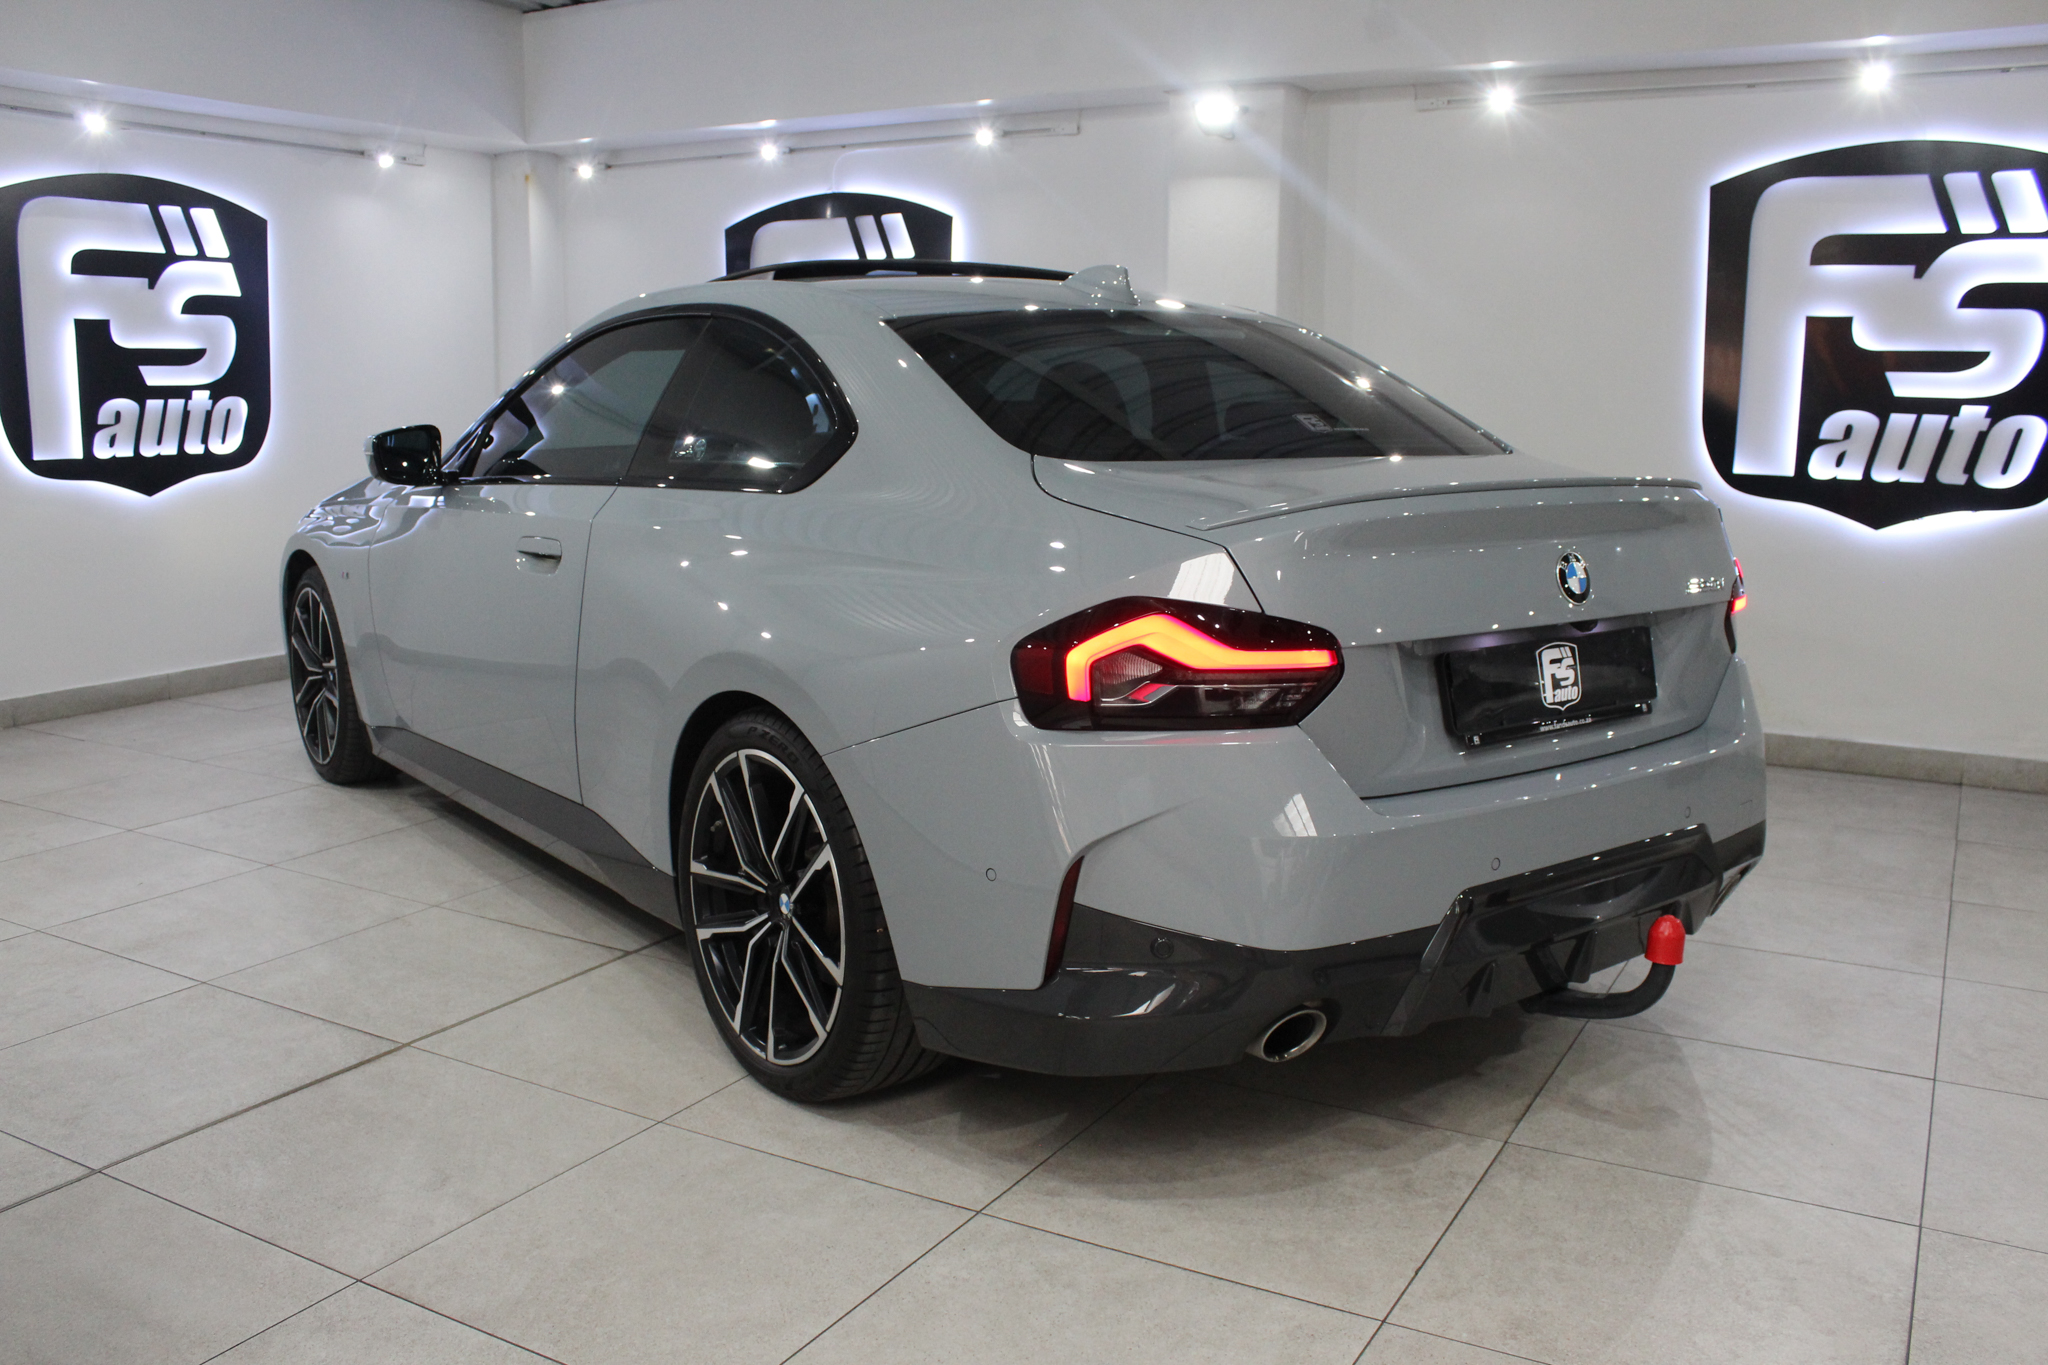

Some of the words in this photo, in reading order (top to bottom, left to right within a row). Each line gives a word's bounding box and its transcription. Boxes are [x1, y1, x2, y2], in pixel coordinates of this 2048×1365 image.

[93, 389, 248, 460] auto
[1807, 404, 2048, 489] auto
[1554, 685, 1579, 703] auto
